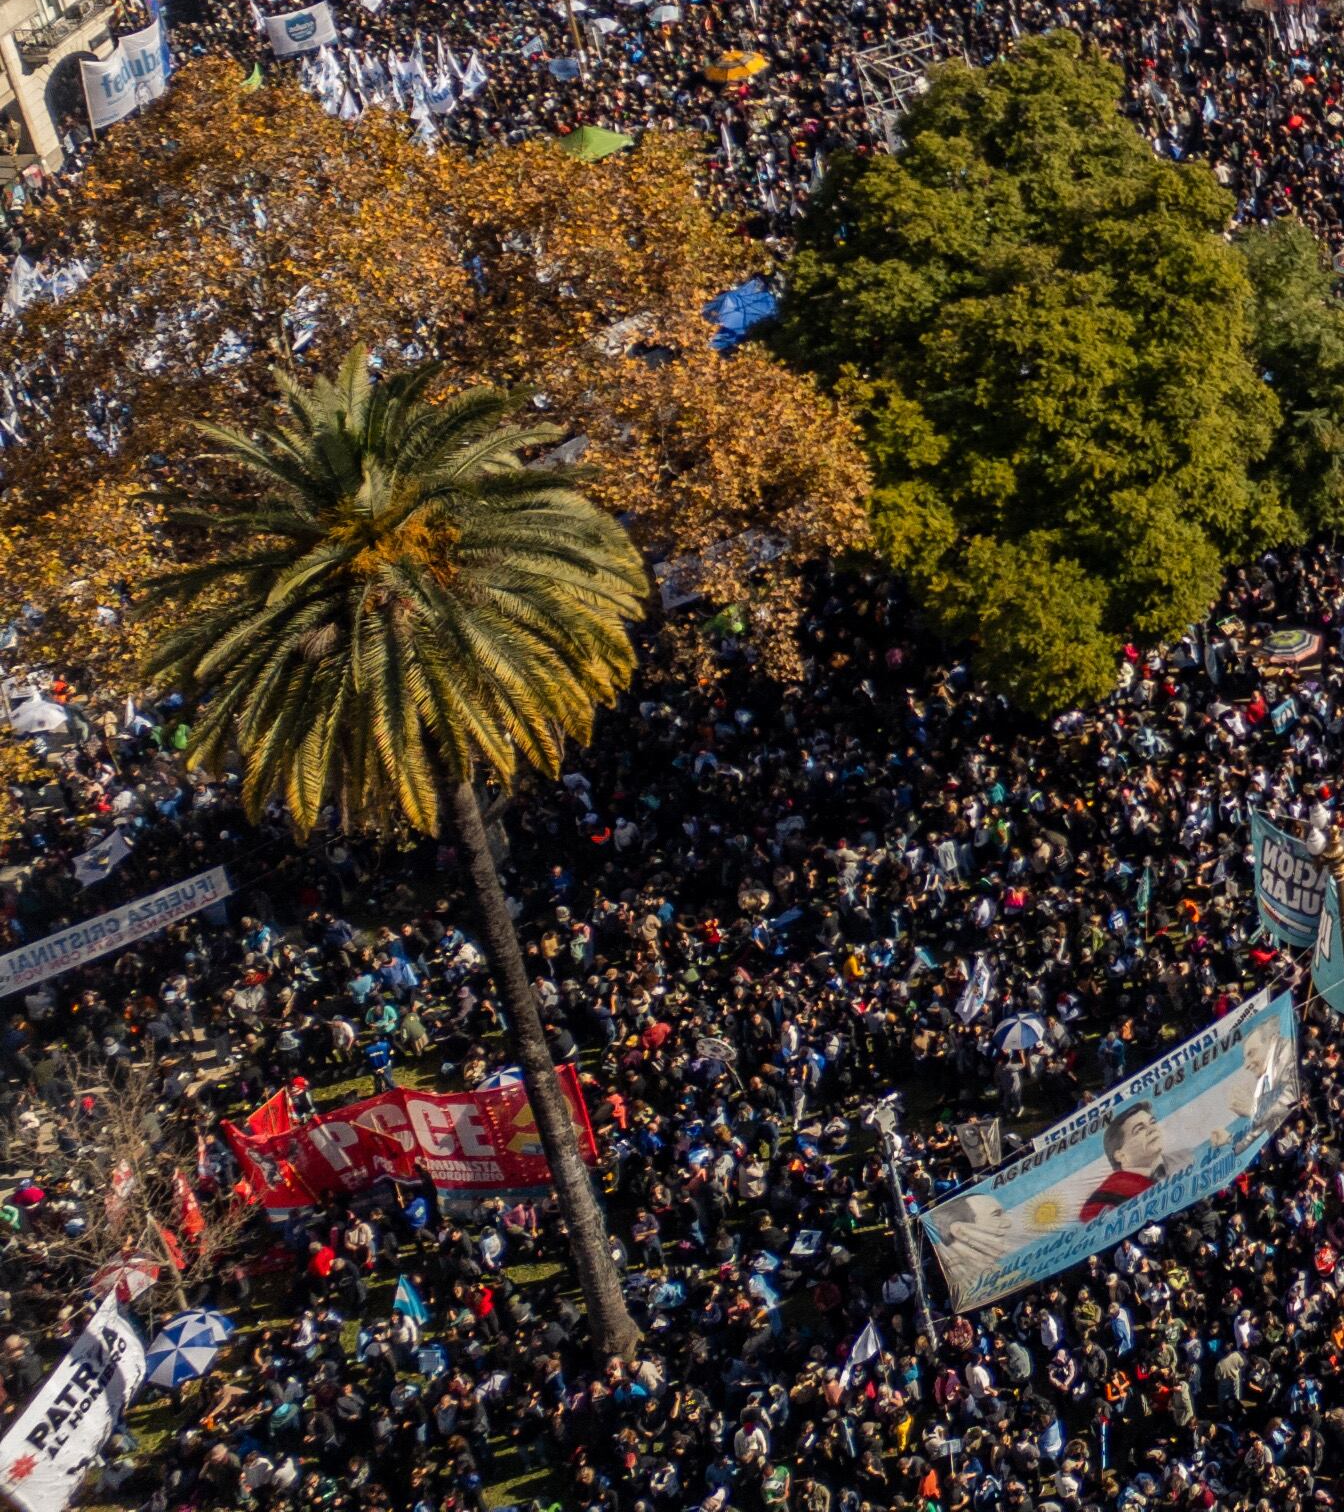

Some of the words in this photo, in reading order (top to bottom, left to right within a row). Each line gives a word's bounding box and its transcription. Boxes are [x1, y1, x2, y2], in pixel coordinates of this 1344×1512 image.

[1152, 1073, 1186, 1098] LOS
[1191, 1029, 1243, 1076] LEIVA
[1104, 1183, 1189, 1240] MARIO
[48, 1432, 70, 1461] AL
